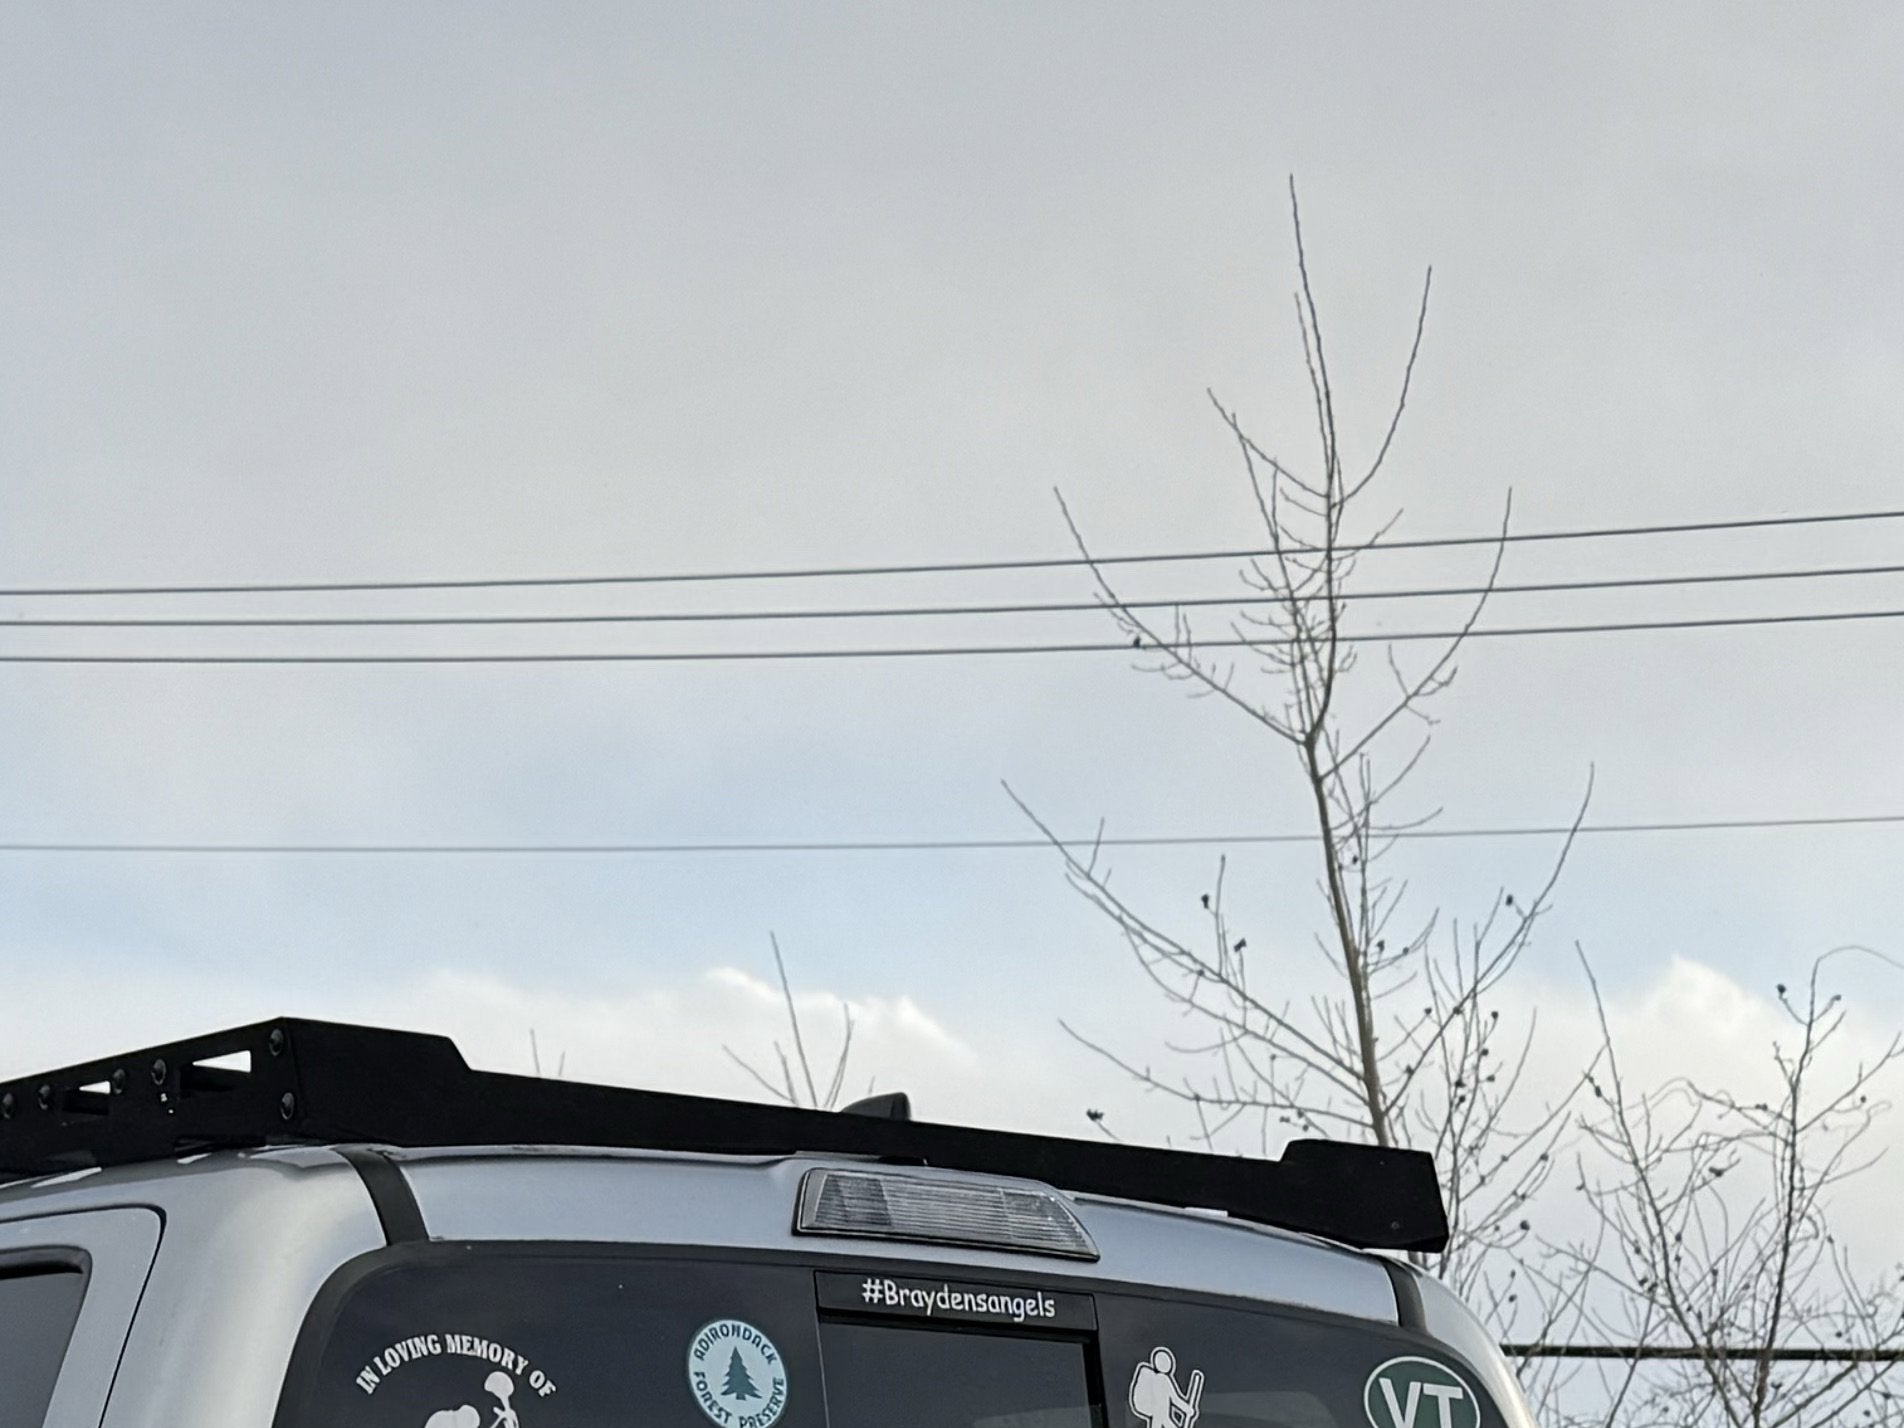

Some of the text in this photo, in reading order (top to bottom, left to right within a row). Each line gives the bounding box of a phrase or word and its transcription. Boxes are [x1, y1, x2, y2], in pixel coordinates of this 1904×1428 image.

[862, 1278, 1056, 1322] #Braydensangels
[356, 1334, 556, 1397] IN LOVING MEMORY OF
[694, 1323, 777, 1365] ADIRONDACK
[694, 1371, 732, 1424] FOREST
